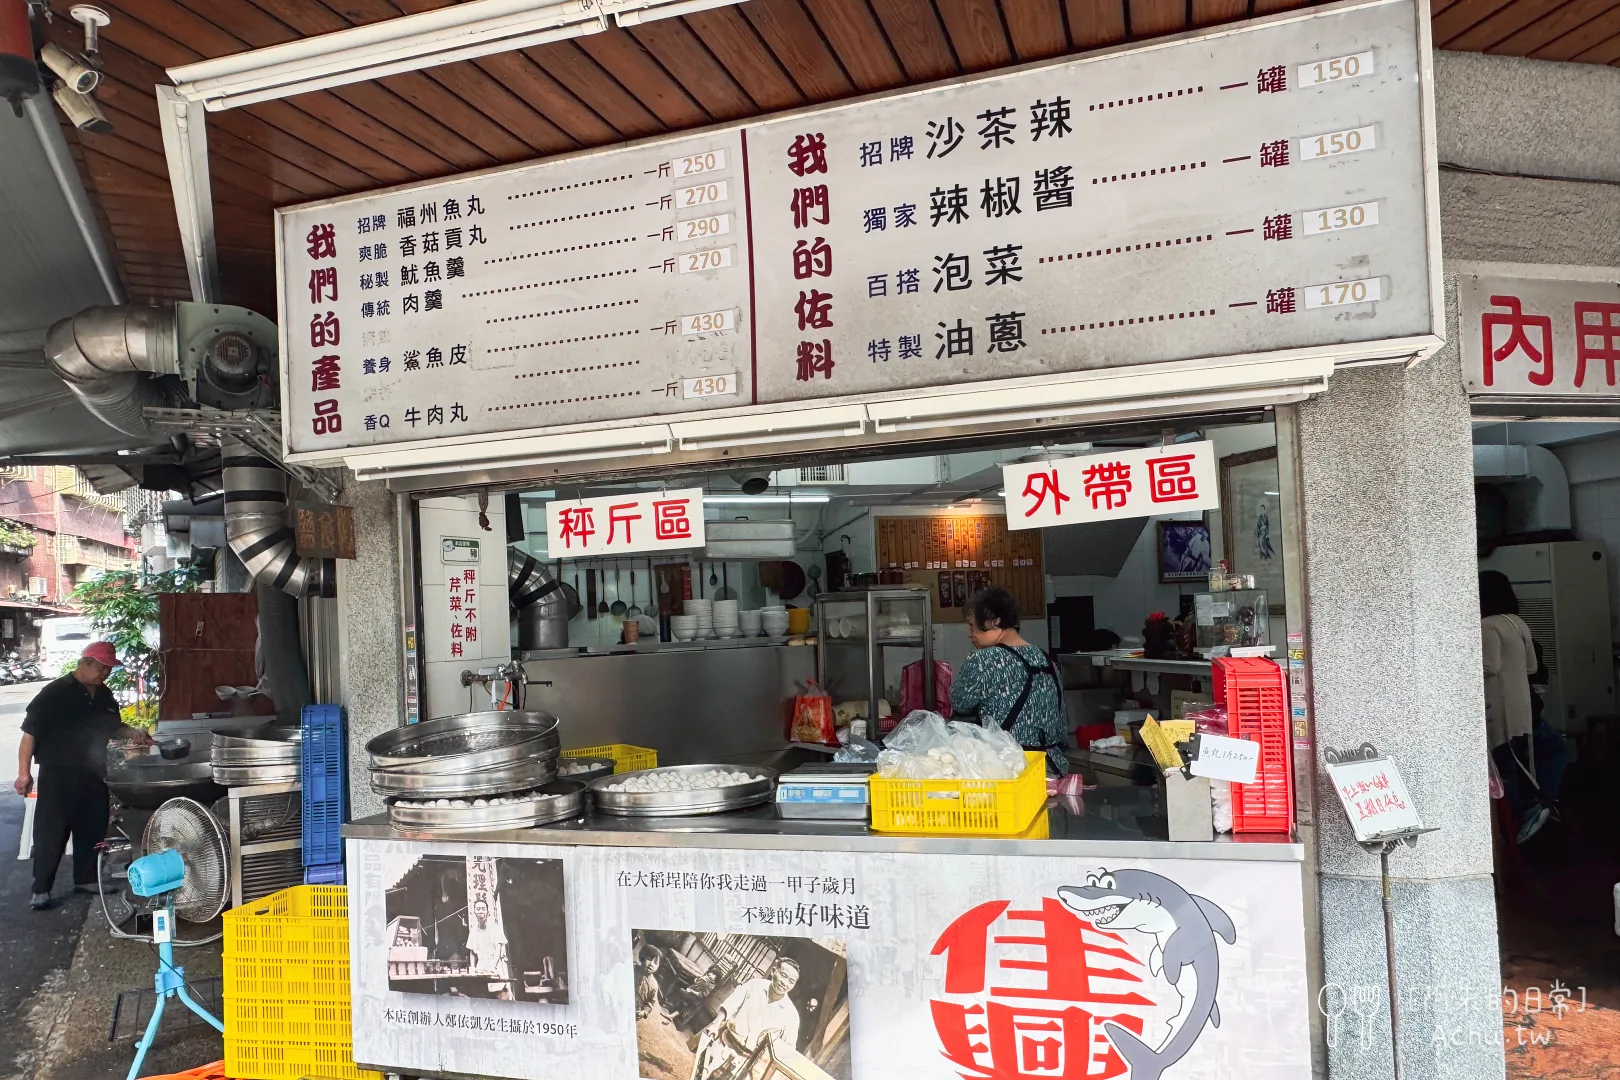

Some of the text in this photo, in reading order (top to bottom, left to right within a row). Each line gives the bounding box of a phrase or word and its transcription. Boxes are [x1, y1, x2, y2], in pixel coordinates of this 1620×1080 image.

[860, 56, 1360, 167] 招牌 沙茶辣 一罐 150
[358, 153, 716, 234] 招牌 福州魚丸 一斤 250
[864, 130, 1362, 233] 獨家 辣椒醬 一罐 150
[359, 186, 718, 262] 爽脆 香菇貢丸 一斤 270
[360, 218, 720, 290] 秘製 魷魚羹 一斤 290
[788, 133, 835, 381] 我們的佐料
[867, 204, 1365, 298] 百搭 泡菜 一罐 130
[361, 251, 722, 318] 傳統 肉羹 一斤 270
[868, 280, 1368, 363] 特製 油蔥 一罐 170
[307, 224, 342, 435] 我們的產品
[363, 313, 725, 374] 養身 鯊魚皮 一斤 430
[1482, 295, 1620, 388] 內用
[364, 377, 727, 430] 香Q 牛肉丸 一斤 430
[559, 499, 692, 549] 秤斤區
[1022, 454, 1199, 518] 外帶區
[449, 577, 463, 657] 芹菜、佐料
[463, 569, 477, 642] 秤斤不附
[616, 870, 856, 895] 在大稻埕陪你我走過一甲子歲月
[741, 902, 871, 930] 不變的好味道
